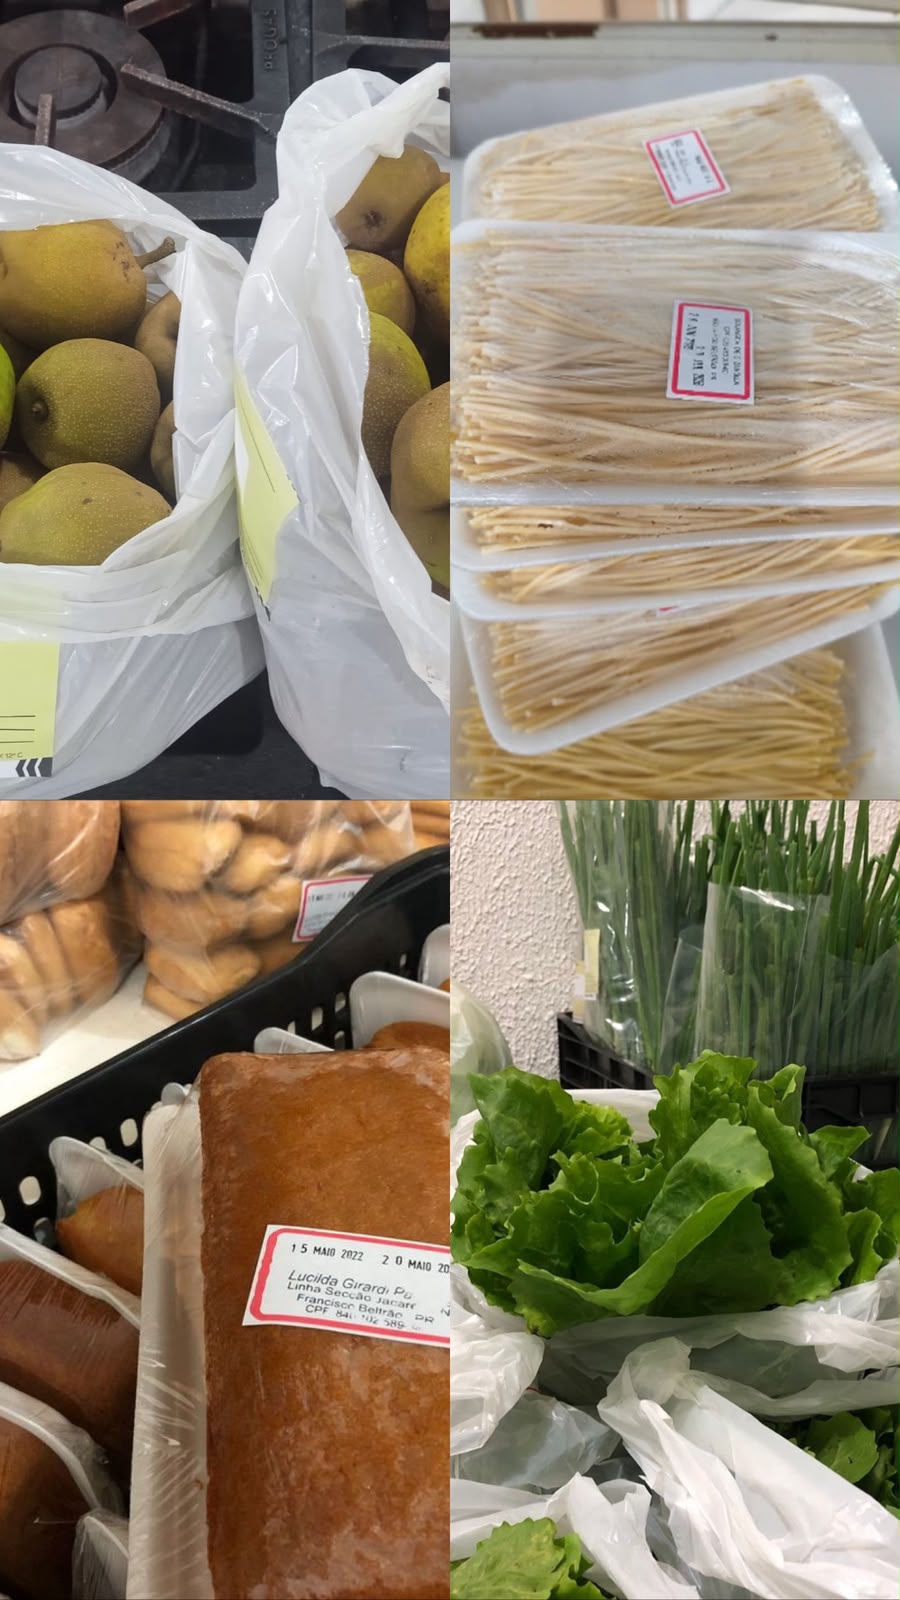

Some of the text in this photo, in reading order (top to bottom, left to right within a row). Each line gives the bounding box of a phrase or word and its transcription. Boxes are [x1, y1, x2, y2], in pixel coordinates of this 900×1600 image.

[312, 1245, 336, 1257] MAIO
[340, 1249, 364, 1262] 2022
[407, 1259, 432, 1272] MAIO
[287, 1269, 338, 1287] Lucilda
[287, 1281, 322, 1294] Linha
[296, 1293, 355, 1309] Francisco
[305, 1304, 329, 1315] CPF
